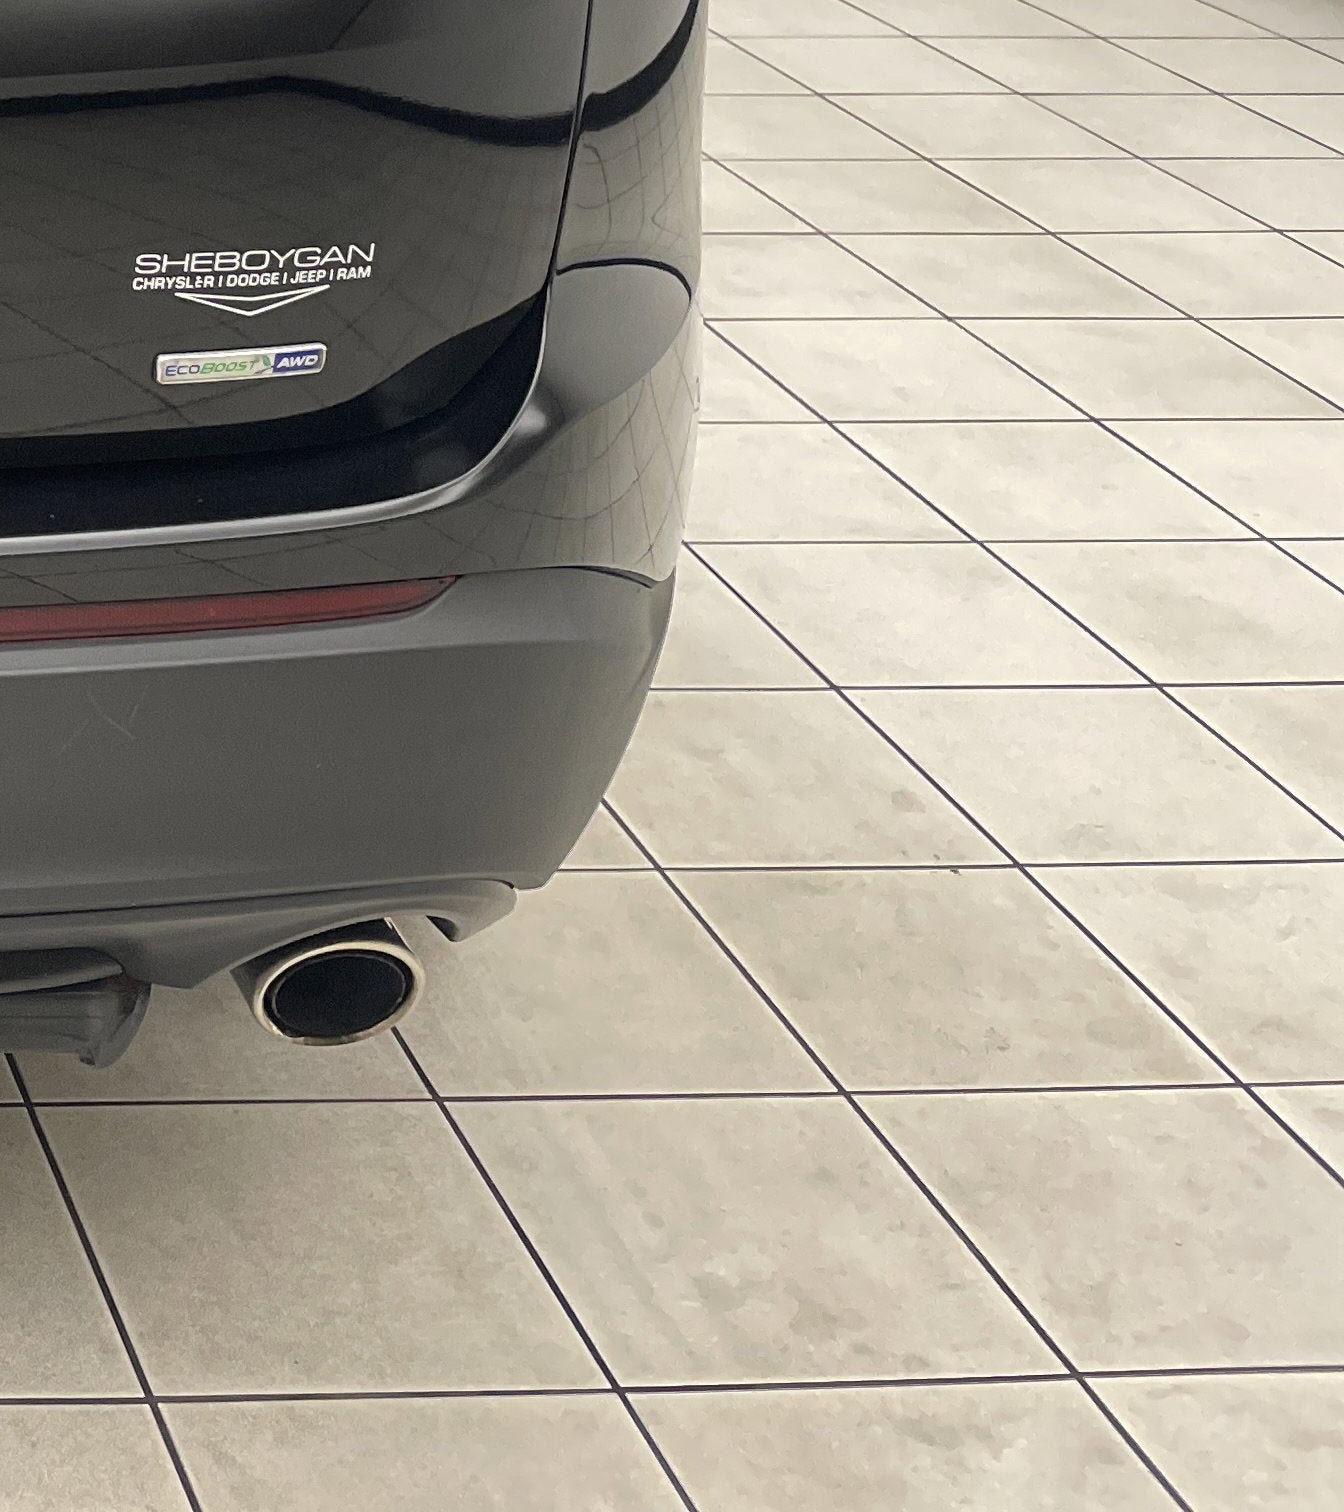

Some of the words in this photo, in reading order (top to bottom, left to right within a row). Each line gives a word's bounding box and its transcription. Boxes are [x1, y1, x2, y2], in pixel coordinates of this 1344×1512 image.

[133, 242, 376, 275] SHEBOYGAN
[131, 276, 215, 291] CHRYSLER
[227, 272, 280, 288] DODGE
[290, 270, 325, 285] JEEP
[336, 265, 372, 281] RAM
[275, 353, 319, 369] AWD
